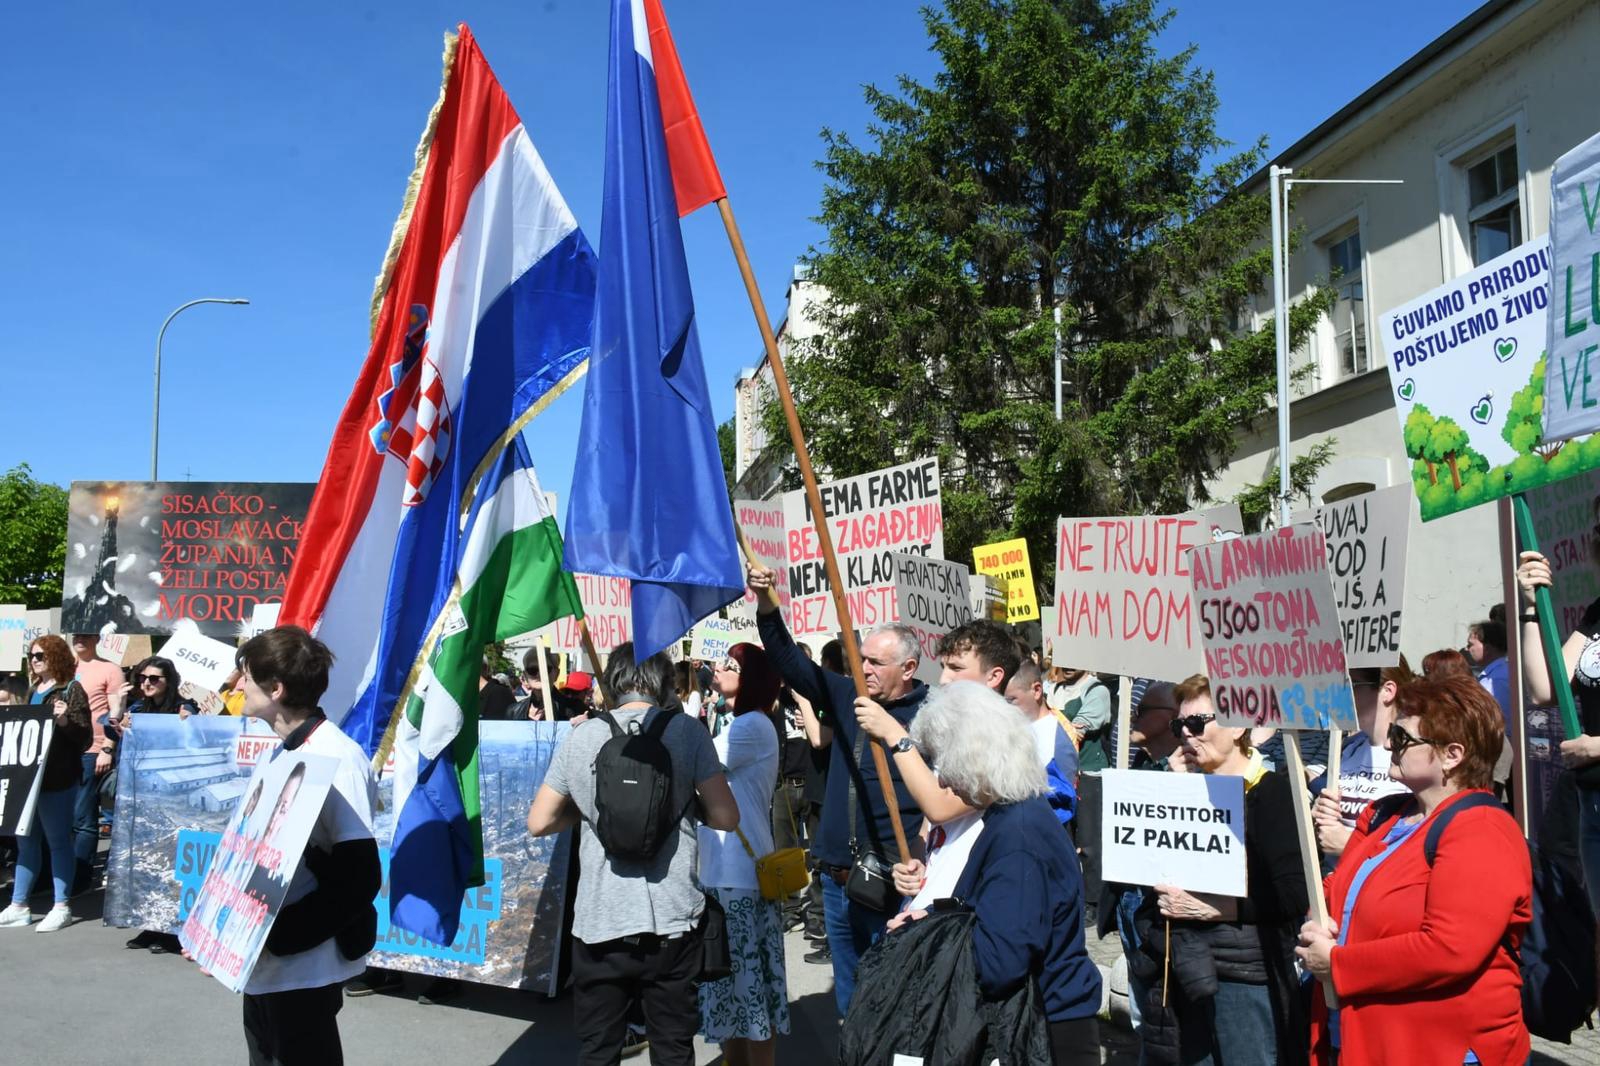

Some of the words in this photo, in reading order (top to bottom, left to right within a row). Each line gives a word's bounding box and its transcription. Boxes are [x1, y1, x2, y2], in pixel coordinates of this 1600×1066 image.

[1392, 289, 1466, 341] ČUVAMO
[1468, 246, 1550, 305] PRIRODU
[1393, 308, 1499, 373] POŠTUJEMO
[1501, 282, 1549, 325] ŽIVO
[160, 490, 264, 515] SISAČKO
[868, 460, 938, 509] FARME
[836, 503, 944, 555] ZAGAĐENJA
[1059, 522, 1094, 571] NE
[1097, 518, 1198, 577] TRUJTE
[160, 538, 276, 569] ŽUPANIJA
[979, 554, 999, 570] 740
[1001, 549, 1023, 566] 000
[1192, 527, 1327, 592] ALARMANTNIH
[1380, 535, 1387, 572] I
[160, 564, 209, 589] ŽELI
[789, 560, 833, 598] NEM
[897, 559, 965, 600] HRVATSKA
[1372, 578, 1386, 607] A
[158, 594, 282, 621] MORD
[792, 596, 828, 635] BEZ
[836, 585, 901, 626] NIŠTE
[907, 593, 972, 630] ODLUČNO
[1058, 588, 1113, 639] NAM
[1123, 587, 1191, 649] DOM
[1201, 596, 1260, 640] 57500
[1253, 588, 1320, 633] TONA
[176, 647, 219, 671] SISAK
[1216, 684, 1282, 727] GNOJA
[237, 741, 252, 760] NE
[1114, 802, 1231, 825] INVESTITORI
[1114, 826, 1136, 846] IZ
[1144, 828, 1230, 855] PAKLA!
